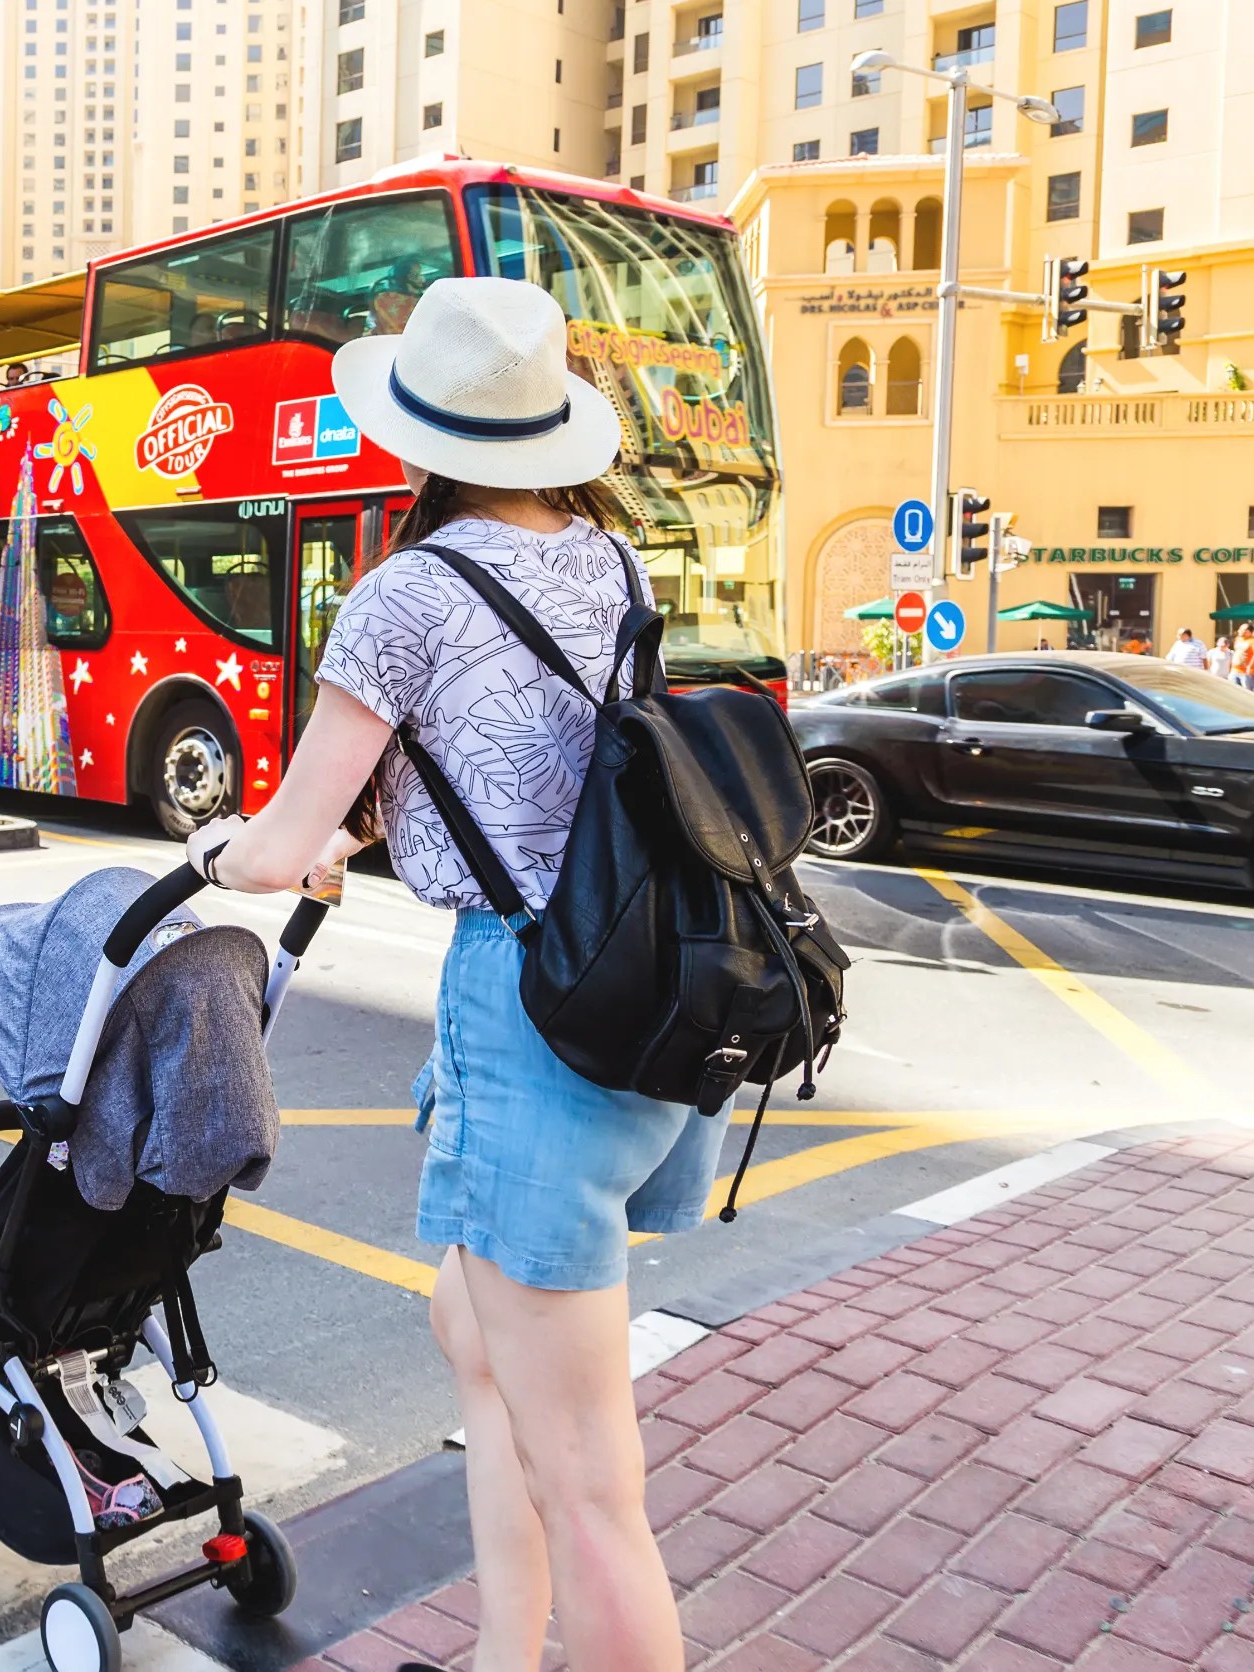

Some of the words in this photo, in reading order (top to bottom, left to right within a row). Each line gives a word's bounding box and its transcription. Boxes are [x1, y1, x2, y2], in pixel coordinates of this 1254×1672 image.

[829, 303, 878, 313] NICOLAS
[661, 386, 750, 448] Dubai
[143, 407, 227, 462] OFFICIAL
[320, 426, 356, 443] dnata
[167, 443, 207, 471] TOUR
[1195, 548, 1254, 563] COF
